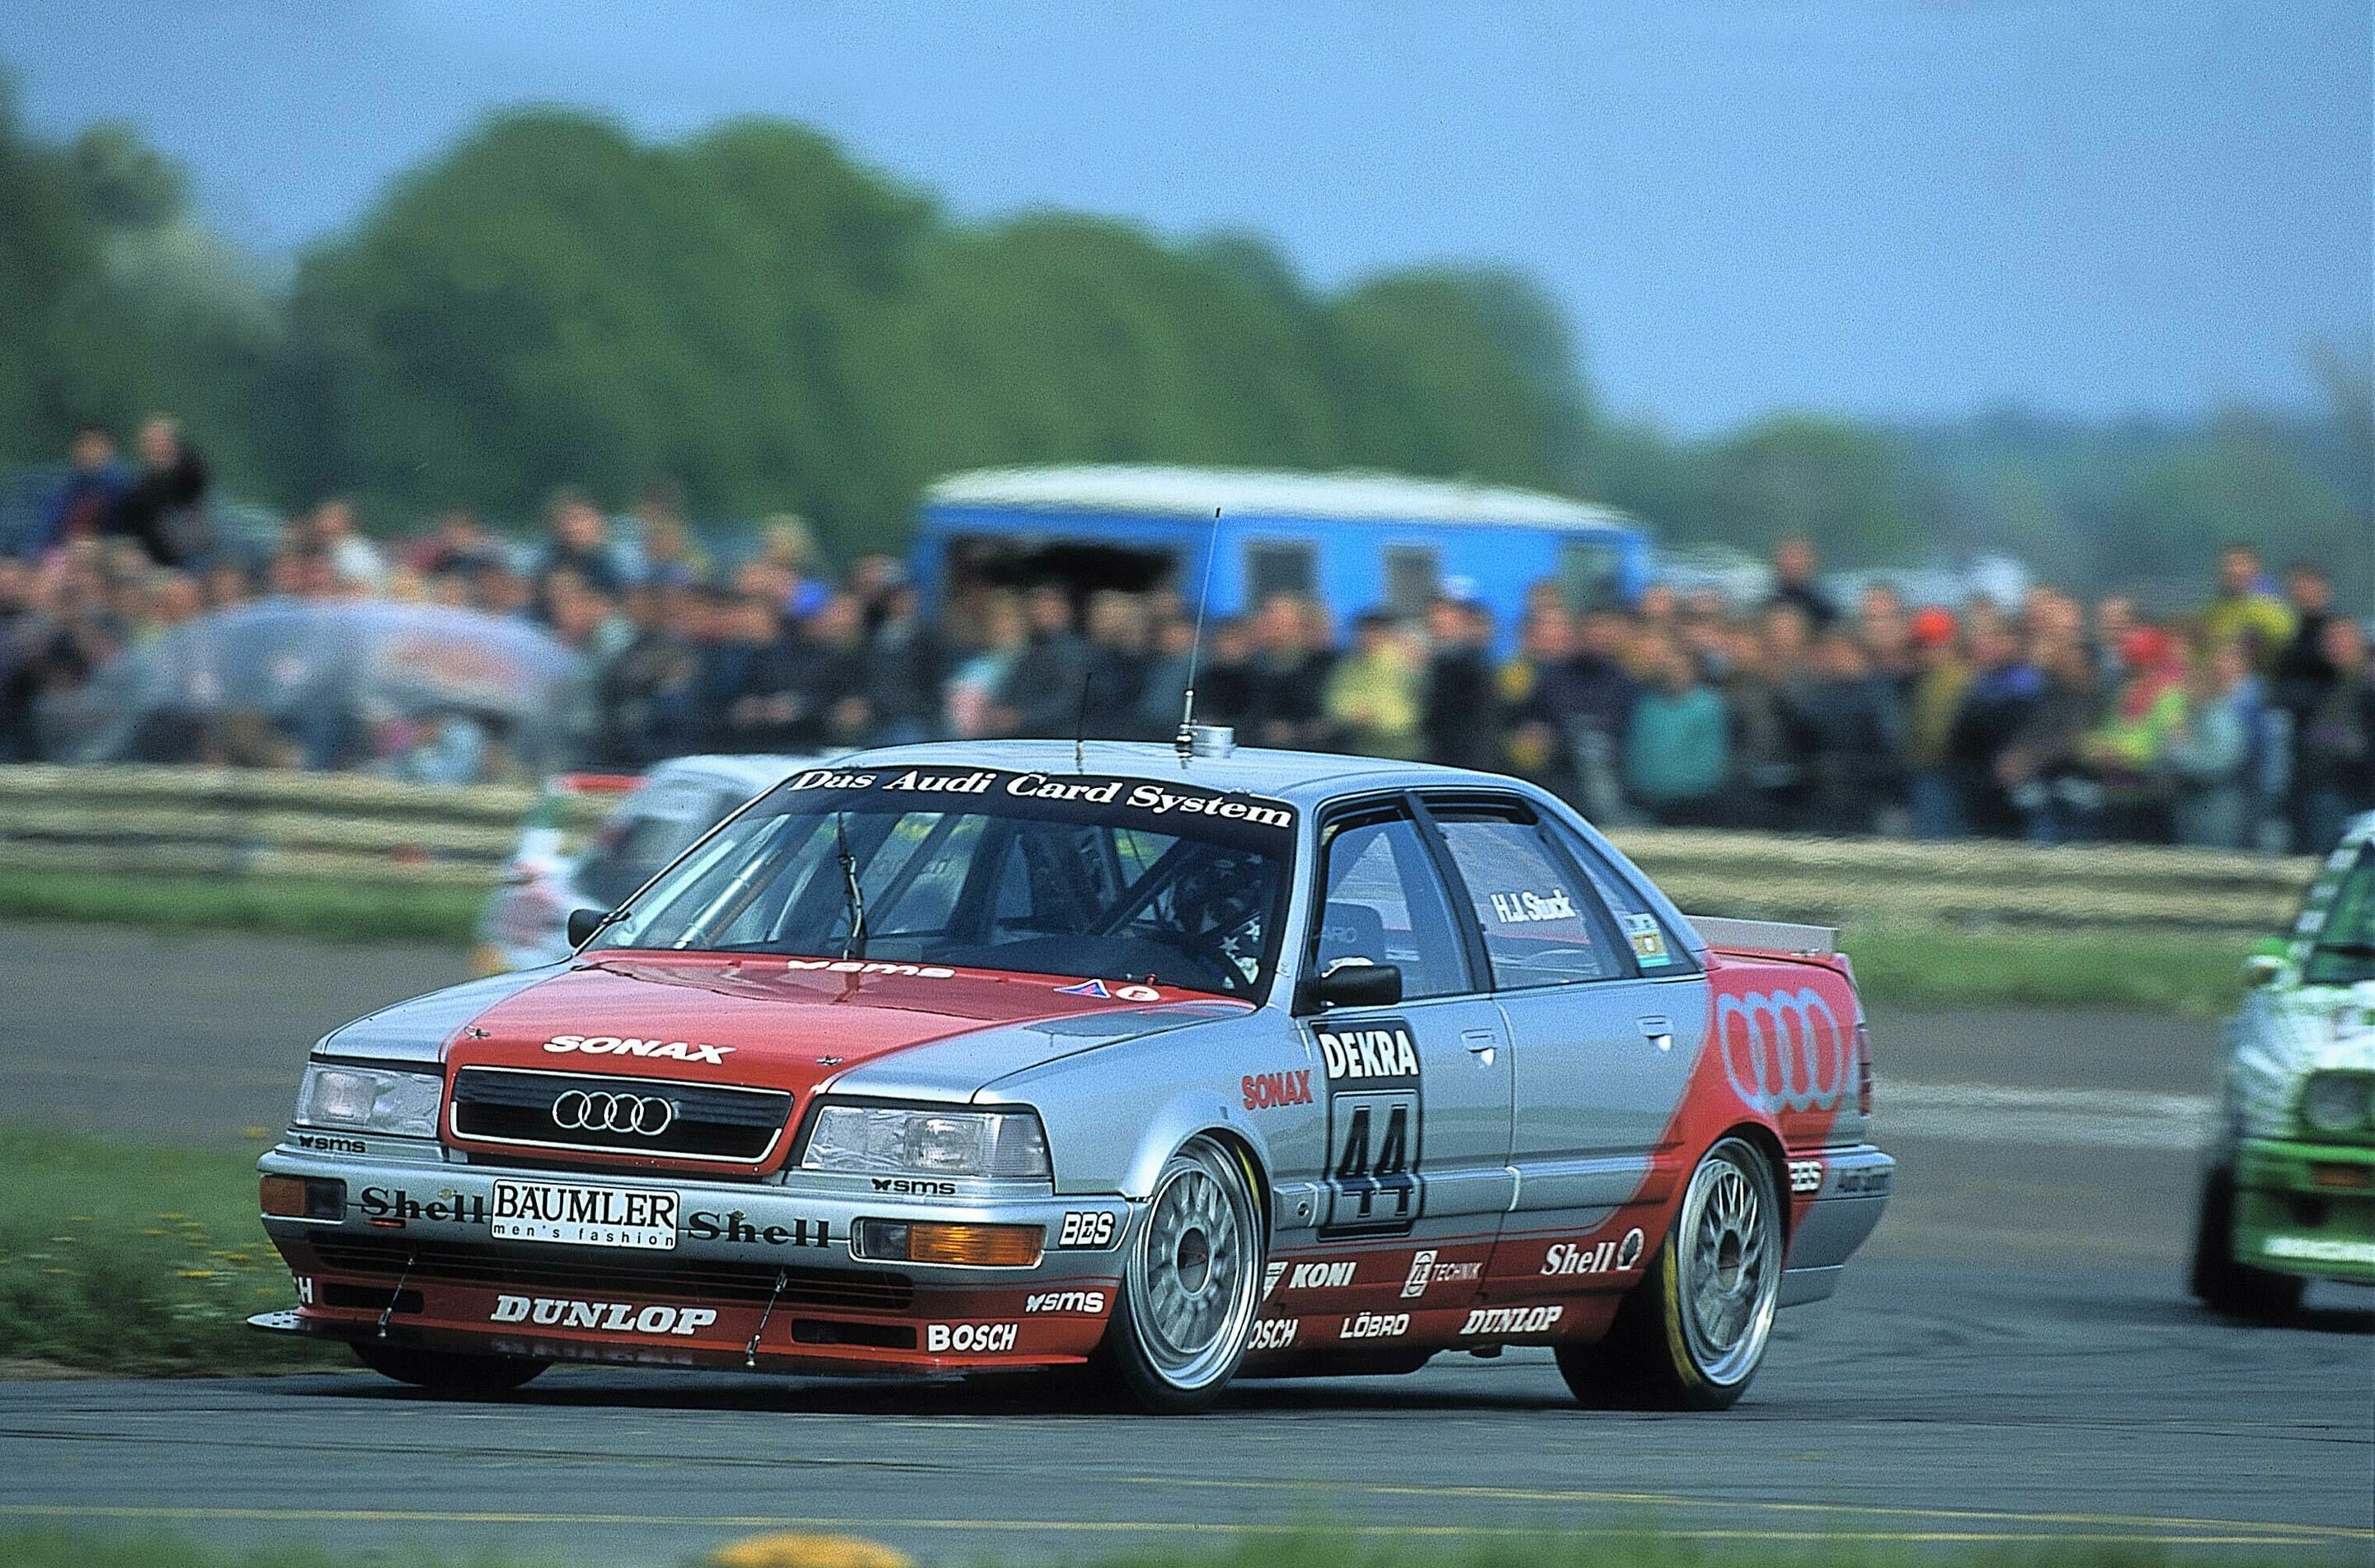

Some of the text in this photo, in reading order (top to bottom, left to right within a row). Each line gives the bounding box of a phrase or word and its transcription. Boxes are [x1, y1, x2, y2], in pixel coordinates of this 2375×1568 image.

[788, 770, 1292, 828] Das Audi Card System
[543, 1035, 738, 1065] SONAX
[1319, 1030, 1419, 1079] DEKRA
[1241, 1069, 1314, 1110] SONAX
[315, 1137, 366, 1153] sms
[1336, 1104, 1416, 1218] 44
[893, 1180, 957, 1195] sms
[359, 1186, 486, 1224] Shell
[495, 1185, 675, 1229] BÄUMLER
[494, 1223, 675, 1248] men's fashion
[689, 1211, 831, 1249] Shell
[1059, 1212, 1115, 1246] BBS
[1540, 1242, 1616, 1275] Shell
[1288, 1262, 1357, 1289] KONI
[491, 1295, 717, 1336] DUNLOP
[1042, 1292, 1105, 1313] sms
[1247, 1318, 1299, 1350] OSCH
[1339, 1312, 1410, 1339] LÖBRO
[1459, 1306, 1564, 1335] DUNLOP
[928, 1324, 1018, 1352] BOSCH
